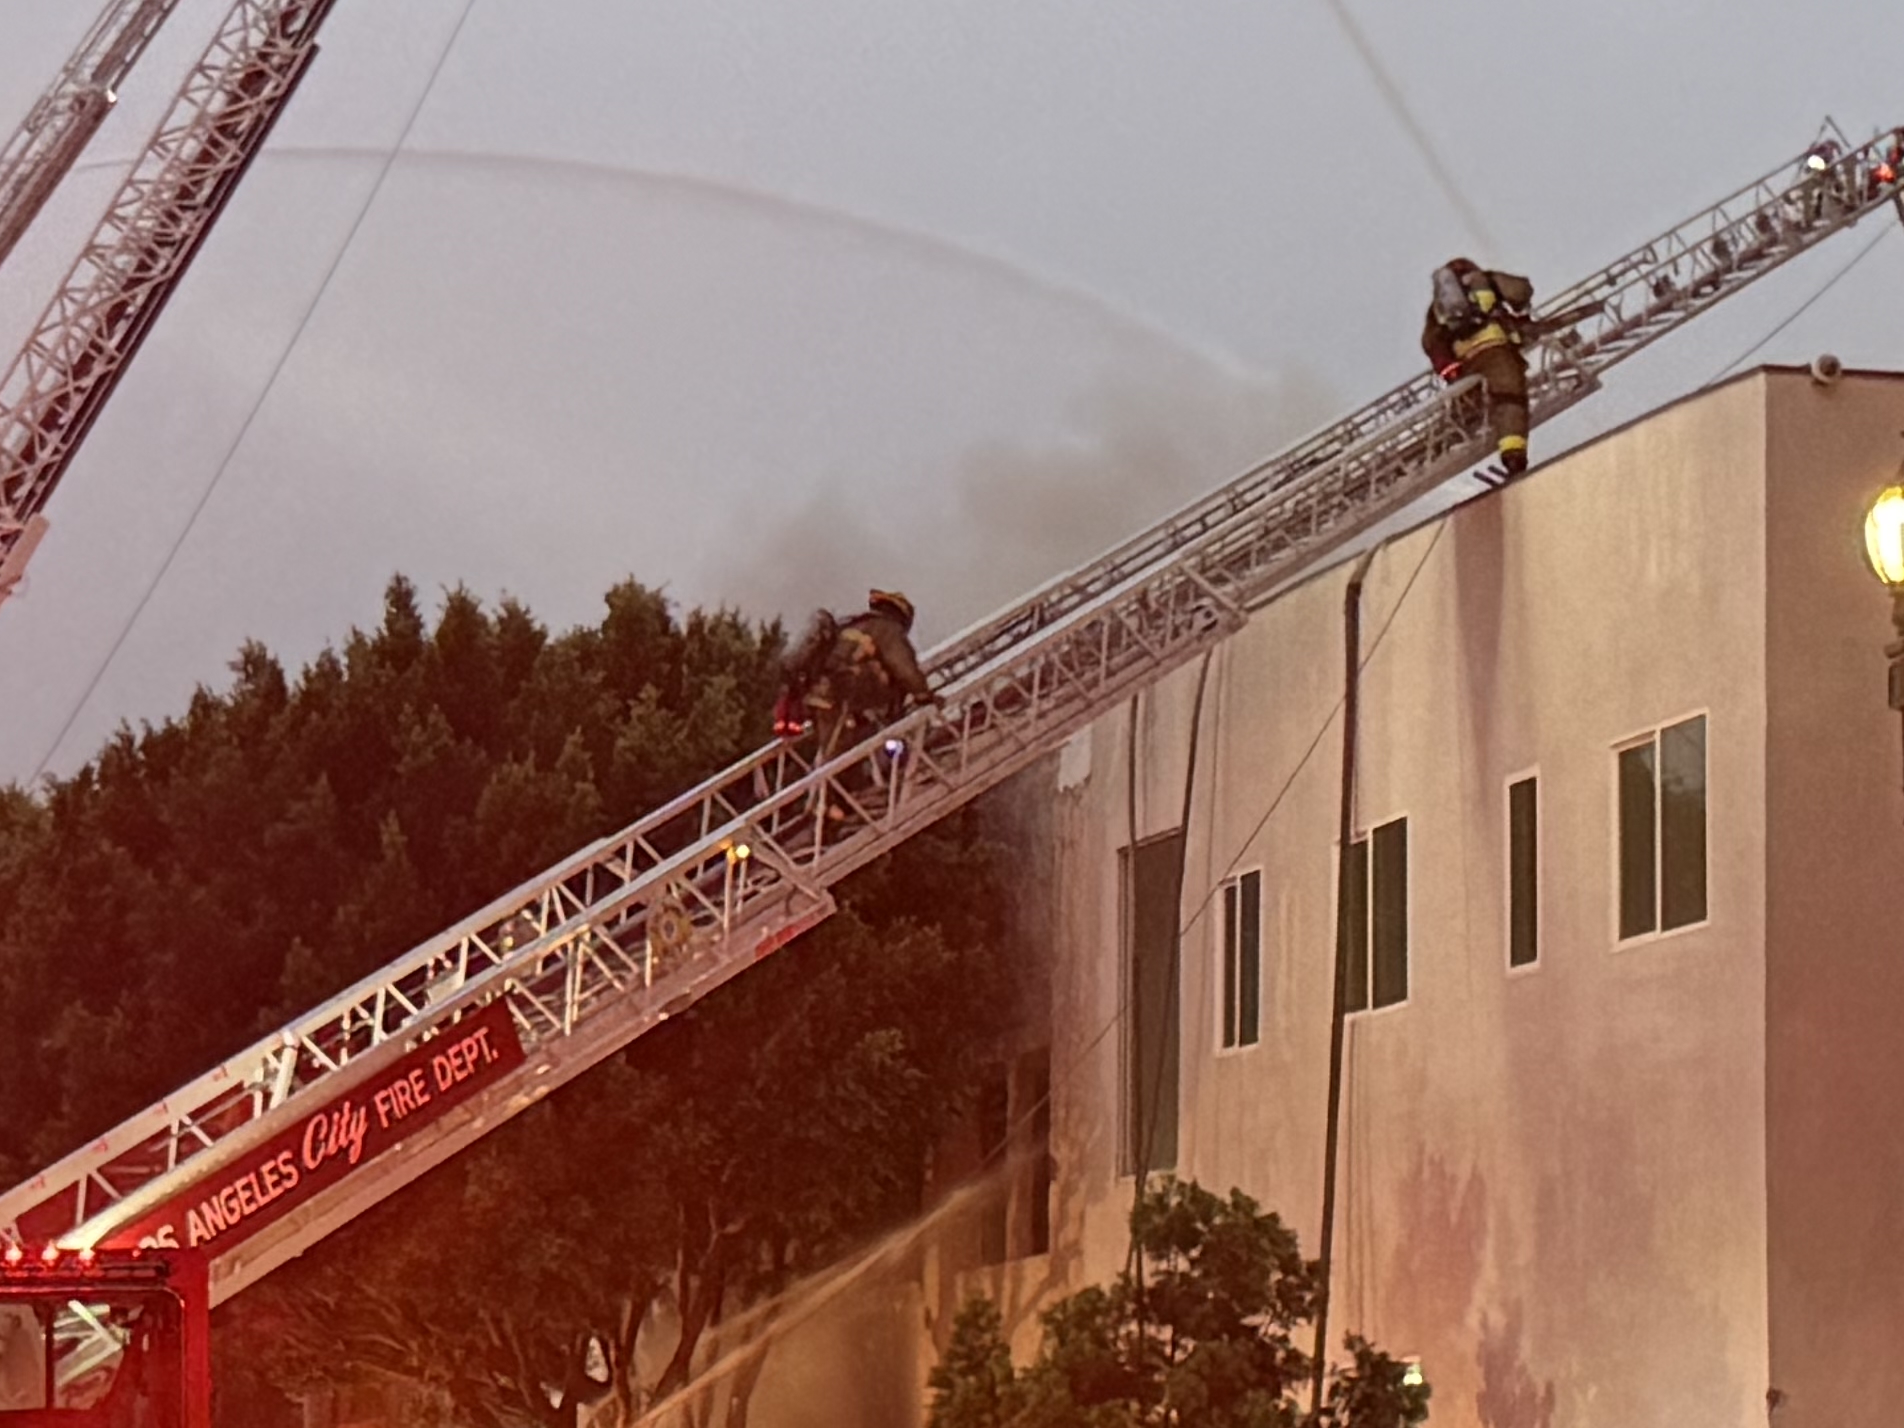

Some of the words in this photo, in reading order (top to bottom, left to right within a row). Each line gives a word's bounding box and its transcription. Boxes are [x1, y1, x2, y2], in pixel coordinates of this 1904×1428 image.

[186, 1149, 300, 1248] ANGELES
[302, 1100, 368, 1170] City
[373, 1067, 431, 1129] FIRE
[432, 1026, 499, 1092] DEPT.
